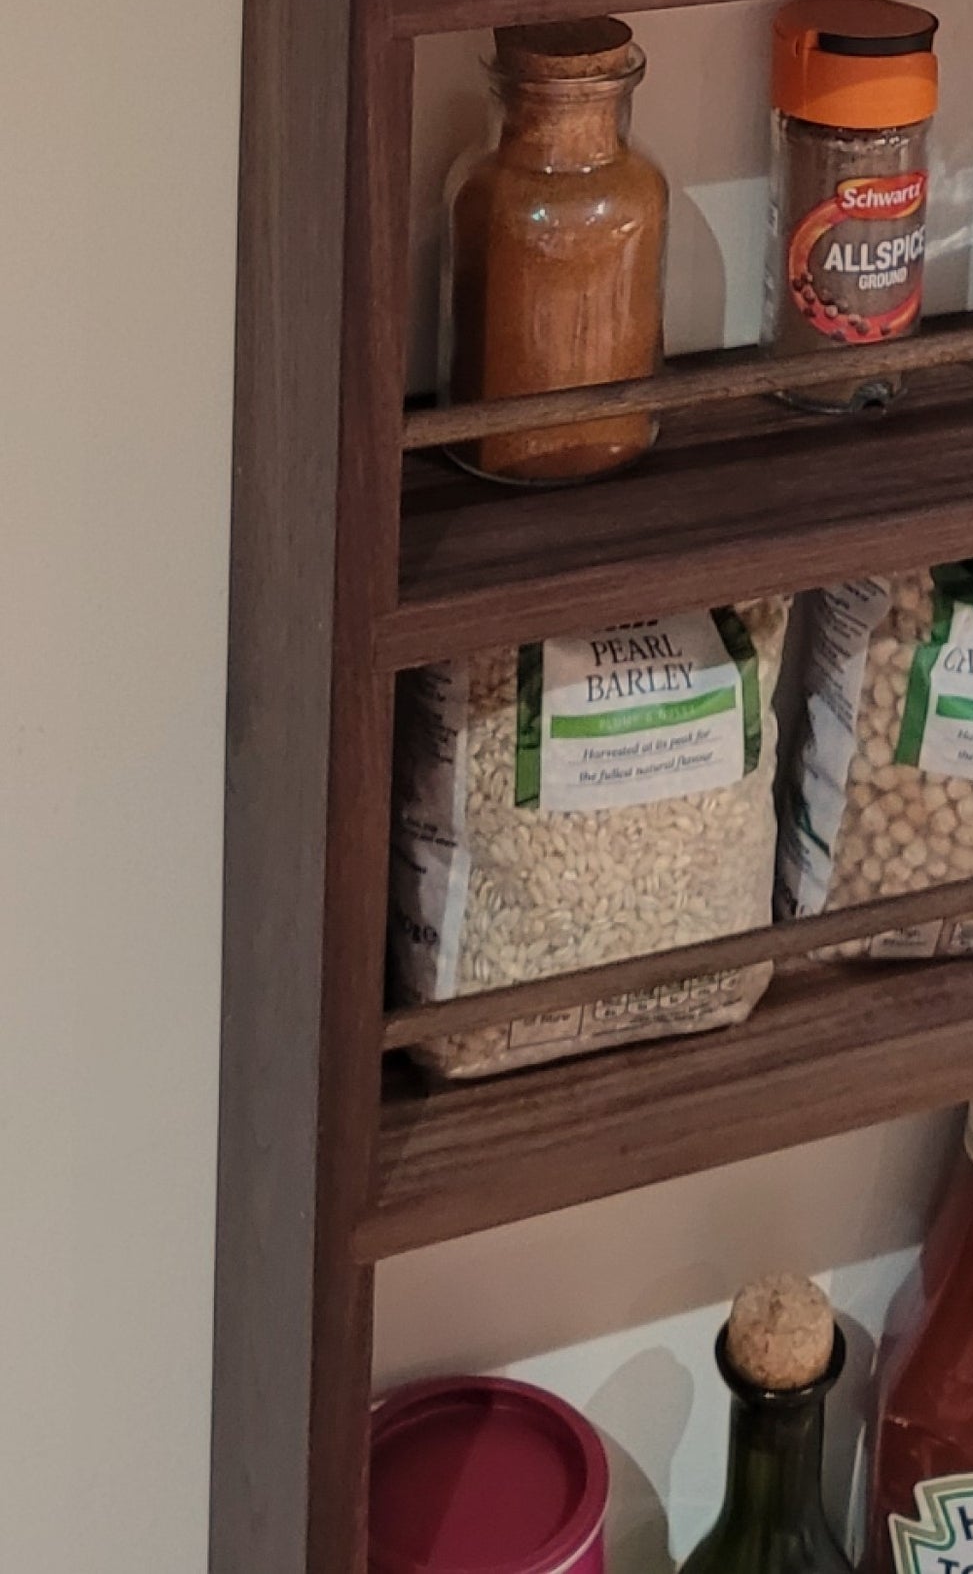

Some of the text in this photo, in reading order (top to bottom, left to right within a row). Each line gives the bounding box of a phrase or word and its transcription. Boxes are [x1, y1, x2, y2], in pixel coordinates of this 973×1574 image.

[858, 266, 908, 291] GROUND
[591, 633, 684, 667] PEARL
[586, 661, 694, 703] BARLEY
[582, 728, 712, 763] Harvested at its peak for
[580, 751, 713, 785] the fullest natural flavour
